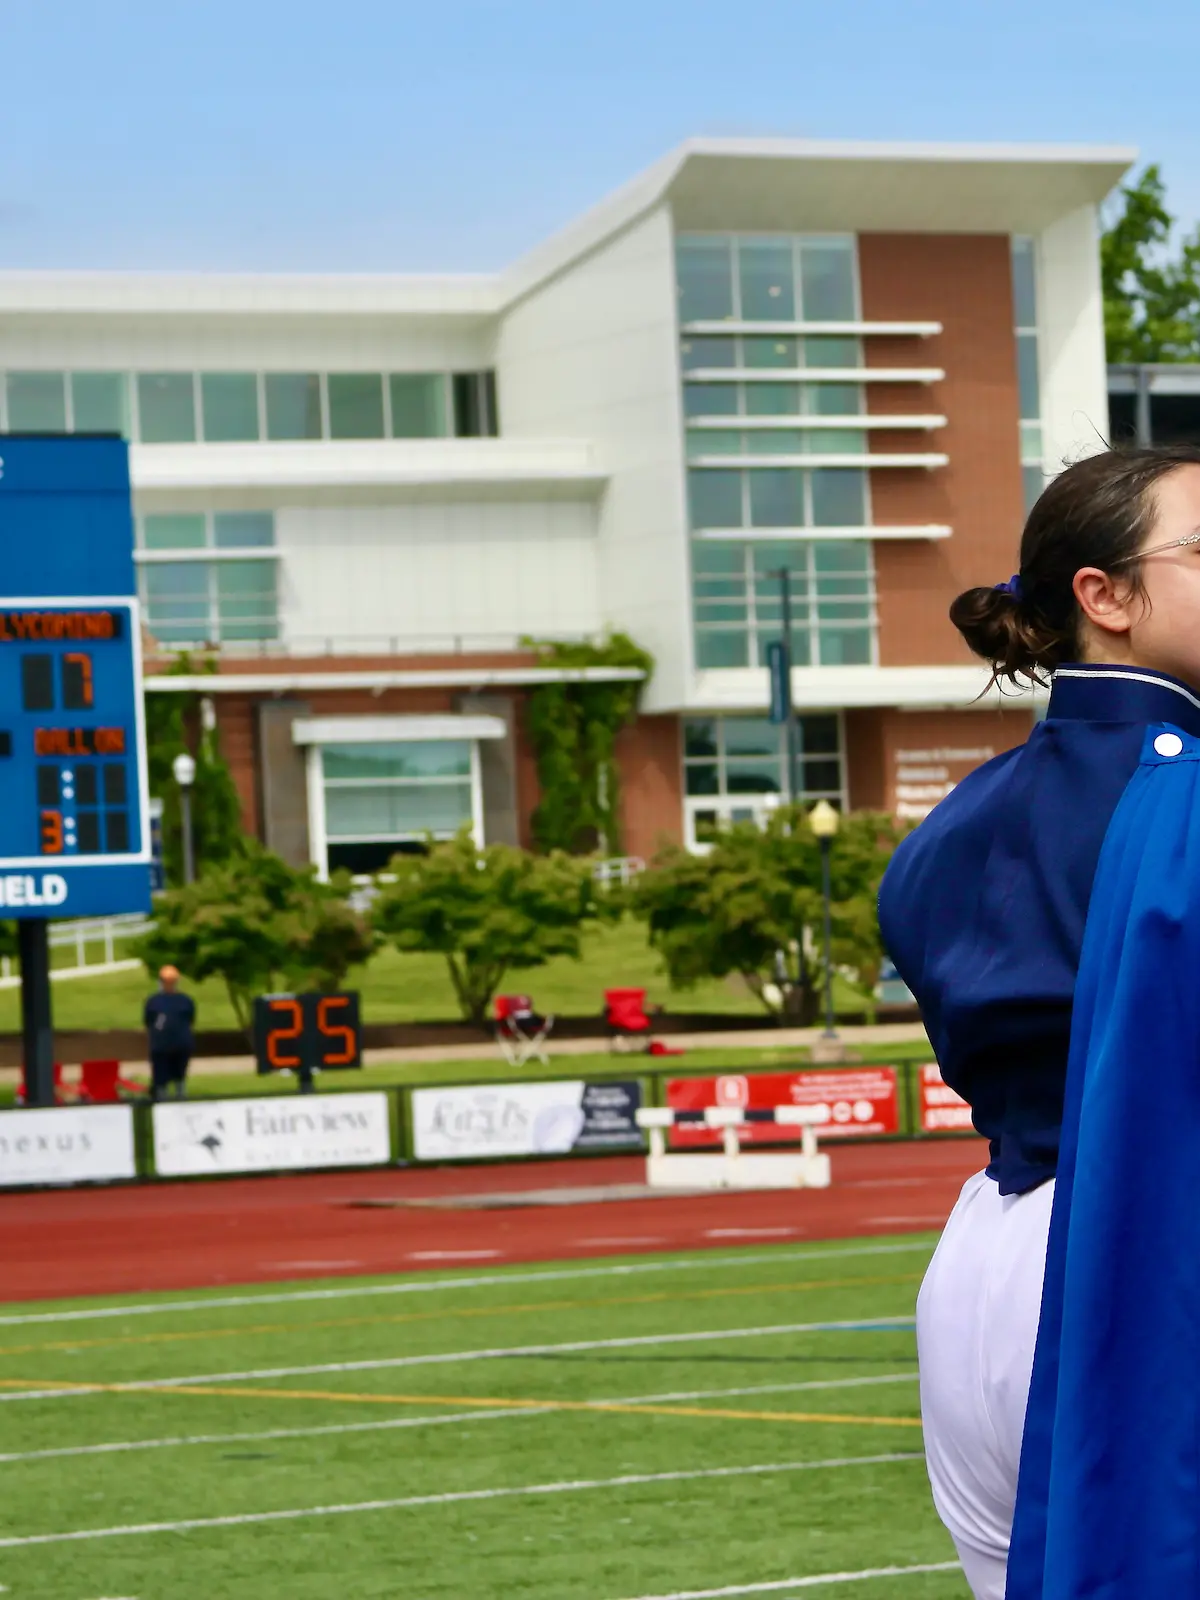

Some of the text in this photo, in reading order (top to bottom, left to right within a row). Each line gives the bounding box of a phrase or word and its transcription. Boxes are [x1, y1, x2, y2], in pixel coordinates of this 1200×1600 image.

[63, 652, 93, 704] 7
[266, 996, 357, 1069] 25
[244, 1102, 371, 1136] Fairview
